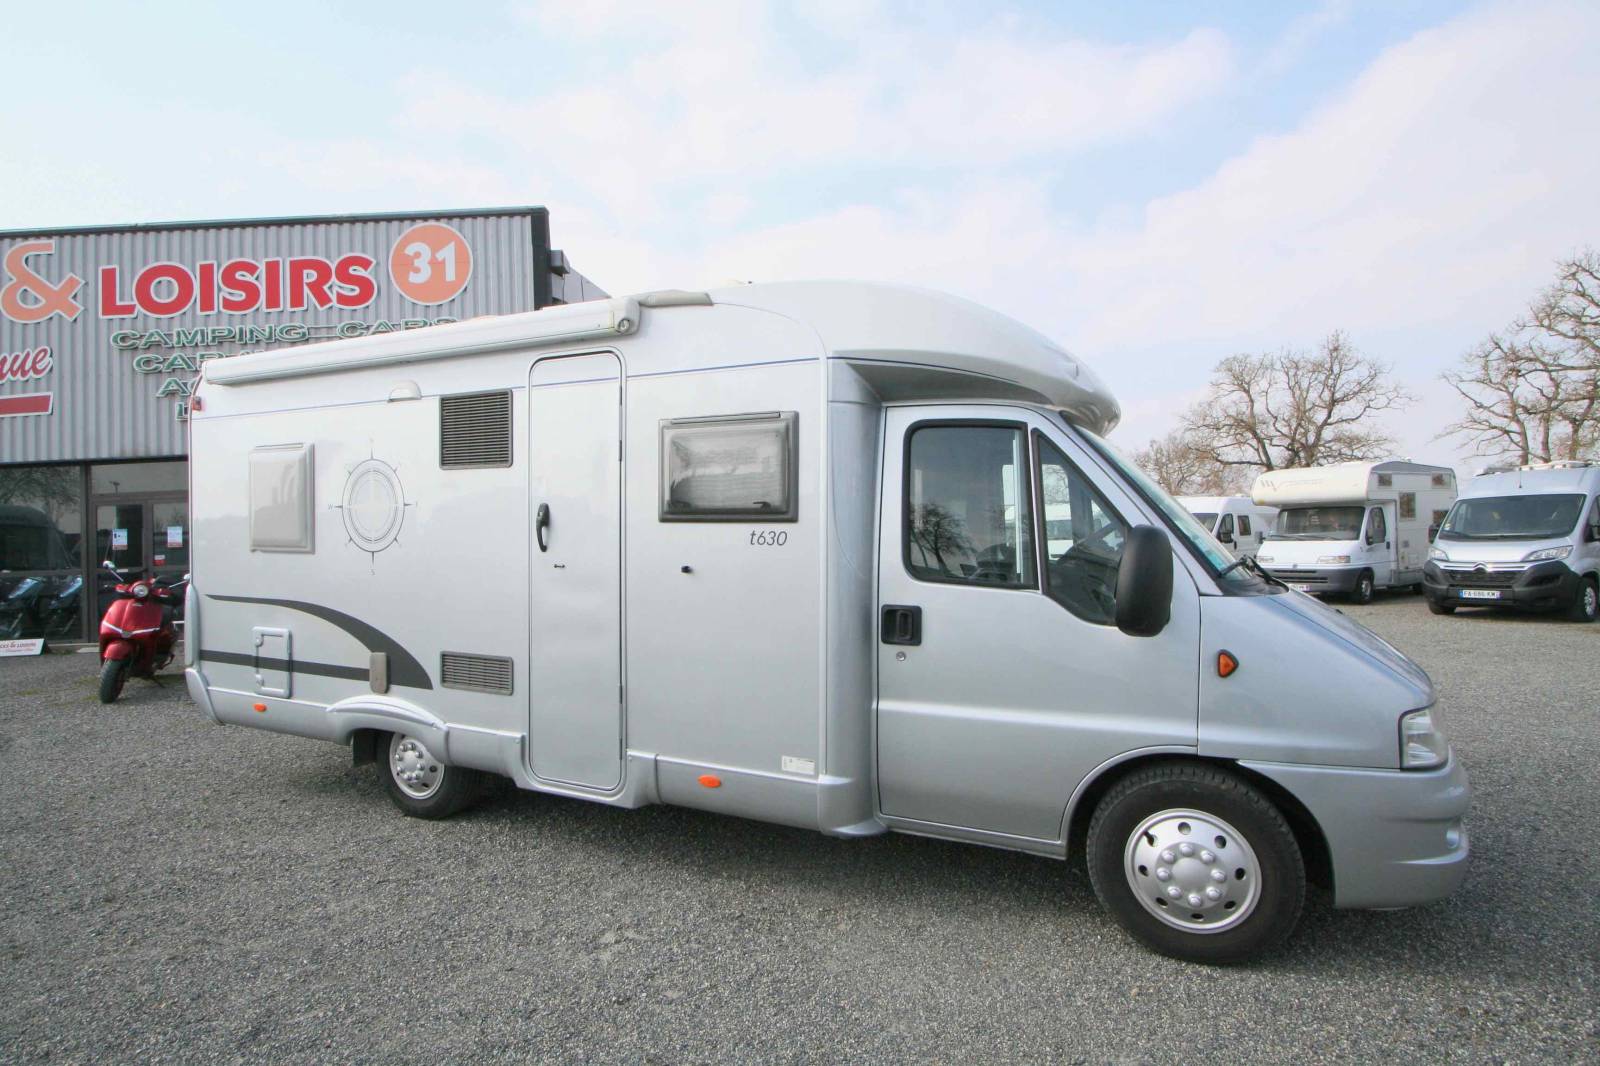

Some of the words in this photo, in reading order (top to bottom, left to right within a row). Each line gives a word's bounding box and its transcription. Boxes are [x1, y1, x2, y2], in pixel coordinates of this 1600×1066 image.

[0, 240, 85, 324] &
[98, 252, 377, 319] LOISIRS
[404, 241, 456, 284] 31
[111, 323, 310, 350] CAMPING
[750, 530, 788, 546] t630
